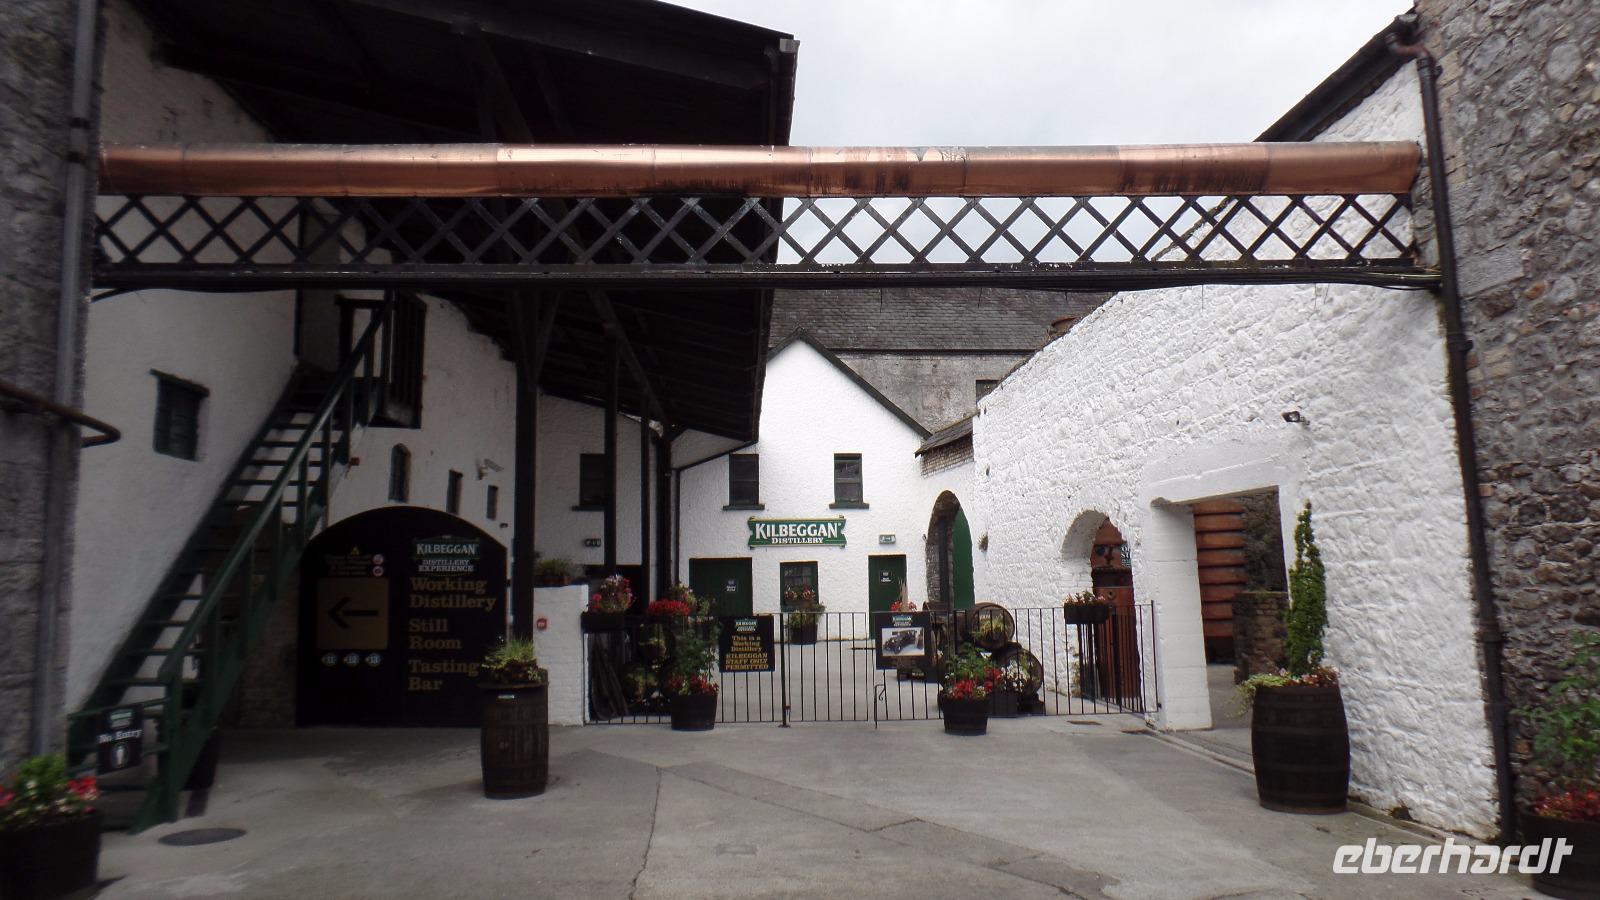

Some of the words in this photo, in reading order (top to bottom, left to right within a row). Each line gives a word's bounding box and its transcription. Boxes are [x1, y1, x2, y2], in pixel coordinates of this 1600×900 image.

[755, 522, 838, 540] KILBEGGAN
[416, 543, 475, 554] KILBEGGAN
[410, 577, 487, 594] Working
[409, 594, 496, 611] Distillery
[408, 618, 448, 632] Still
[408, 635, 462, 650] Room
[408, 659, 480, 677] Tasting
[408, 676, 443, 691] Bar
